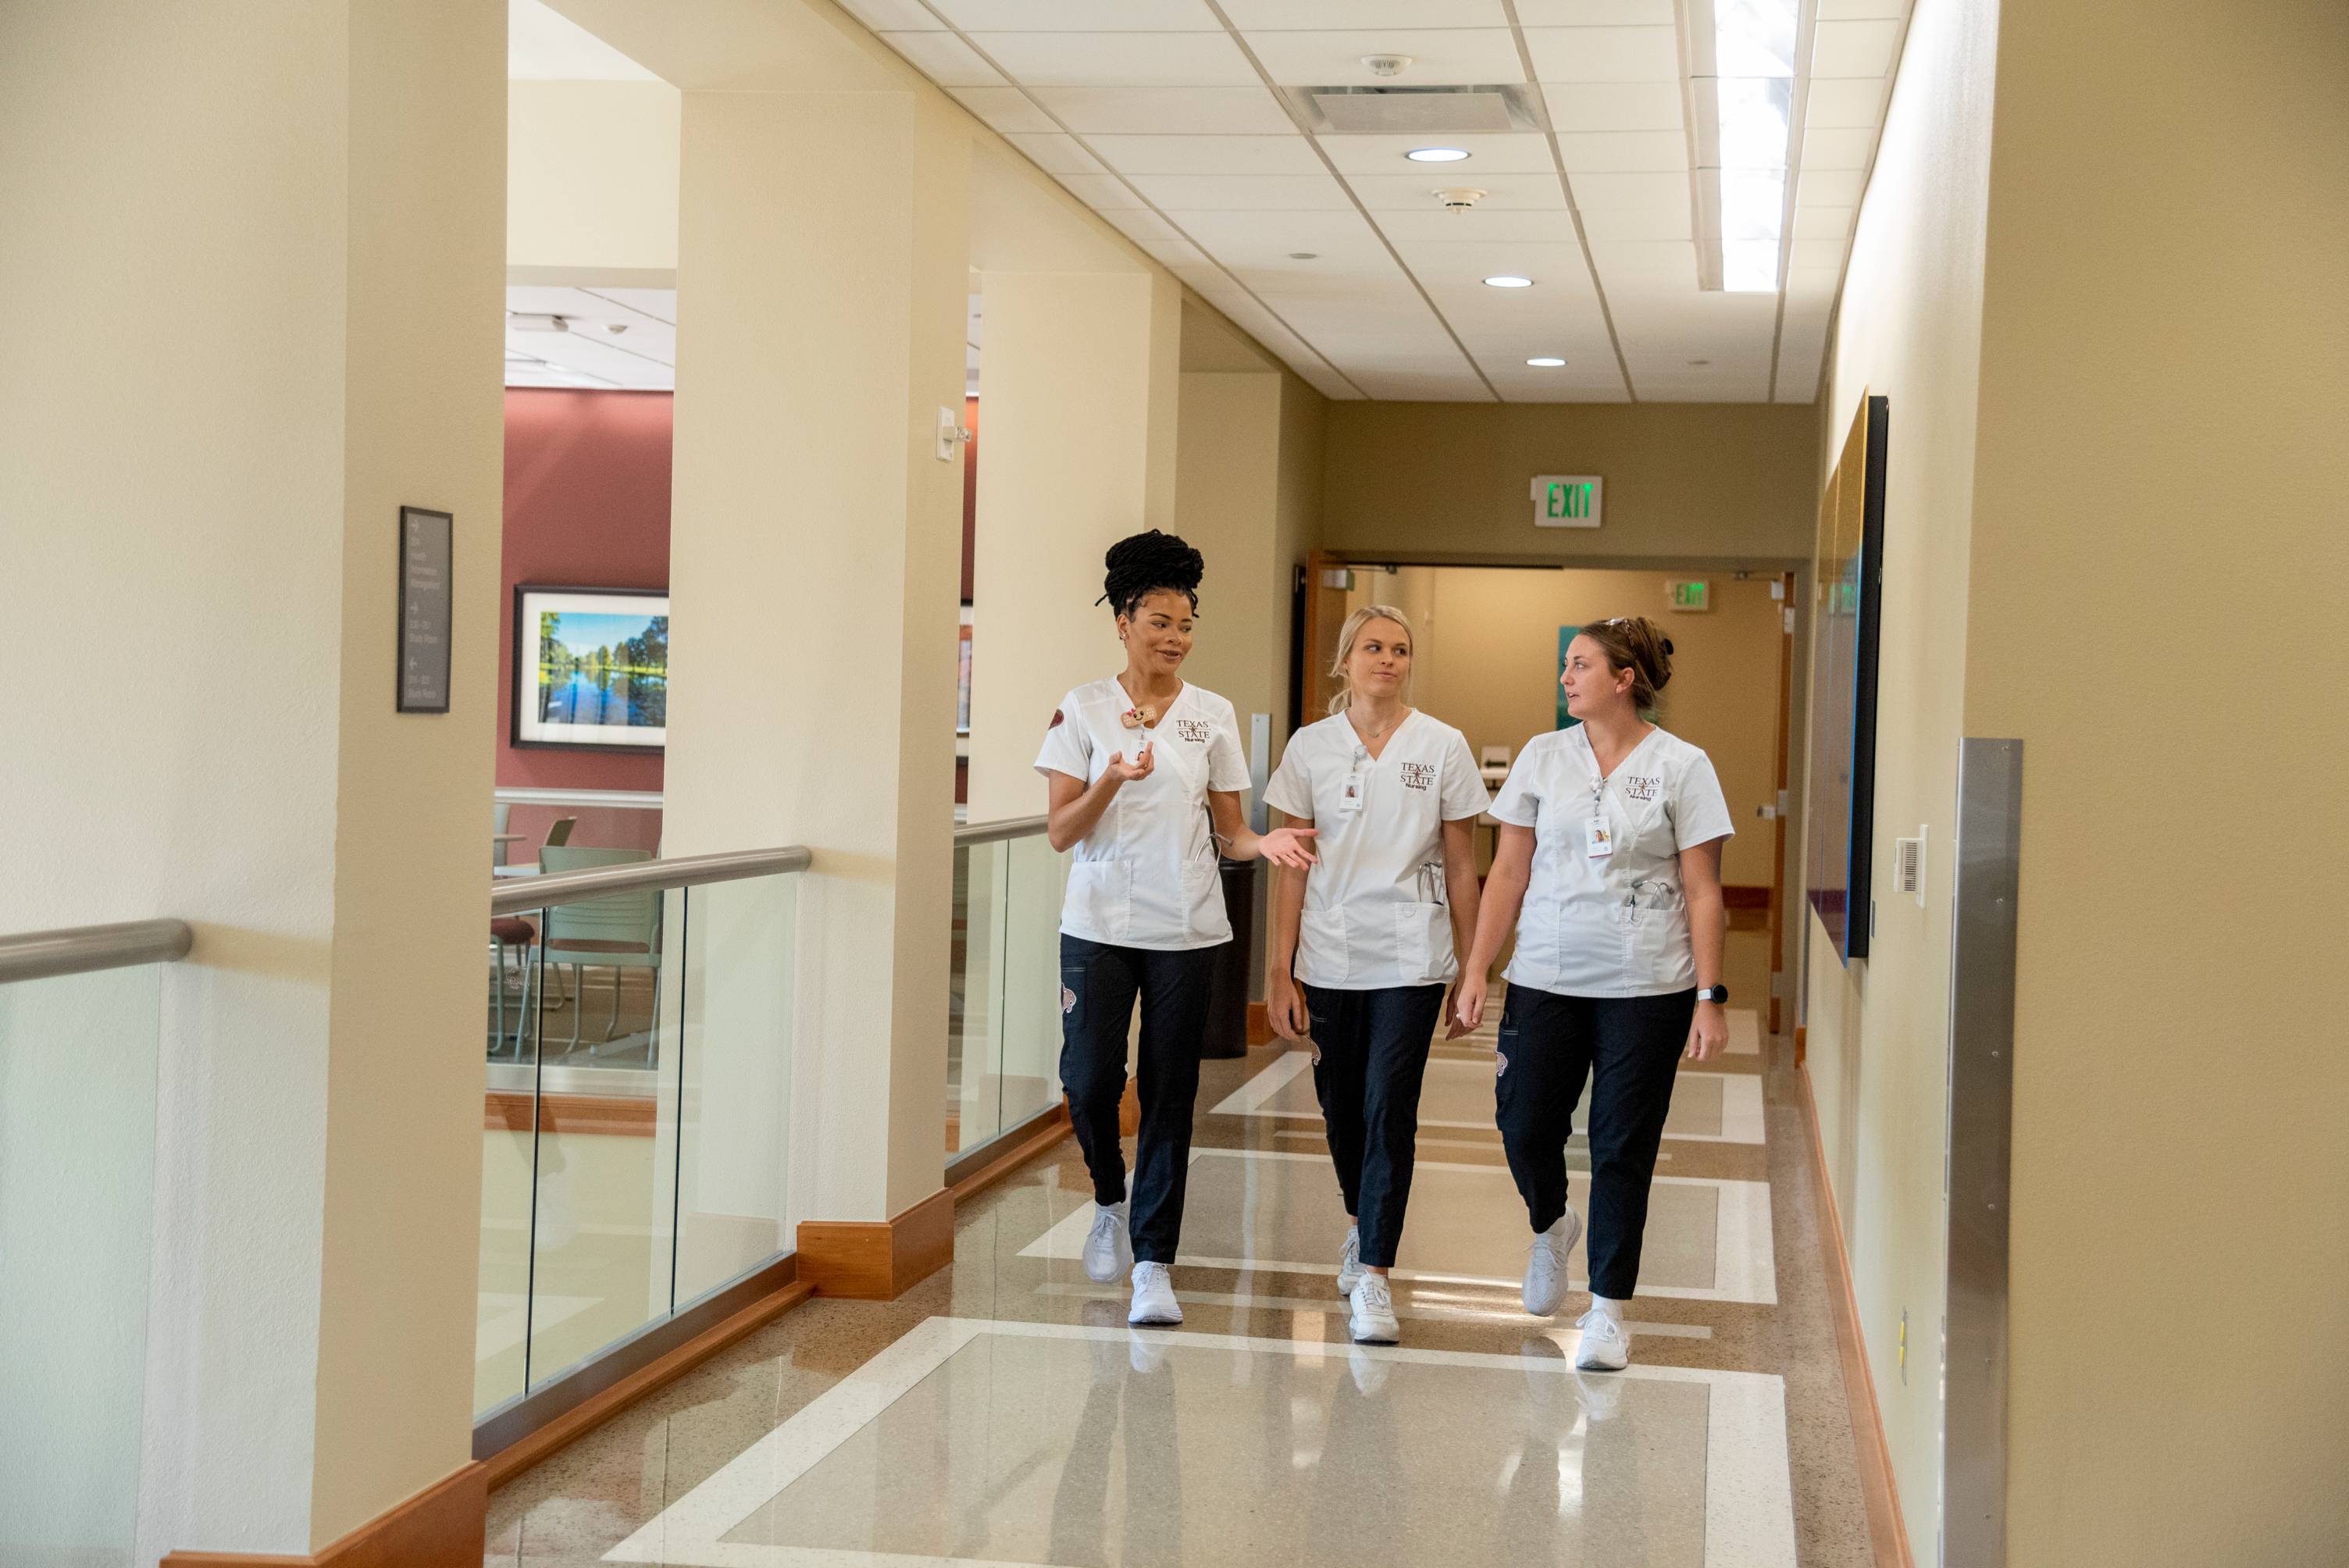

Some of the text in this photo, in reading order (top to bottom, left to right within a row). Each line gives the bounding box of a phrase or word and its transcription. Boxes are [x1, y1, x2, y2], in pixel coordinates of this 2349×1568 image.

[1548, 483, 1593, 518] EXIT
[1176, 719, 1209, 728] TEXAS
[1178, 730, 1210, 739] STATE
[1401, 762, 1435, 773] TEXAS
[1400, 774, 1434, 786] STATE
[1627, 776, 1660, 786] TEXAS
[1625, 788, 1658, 796] STATE
